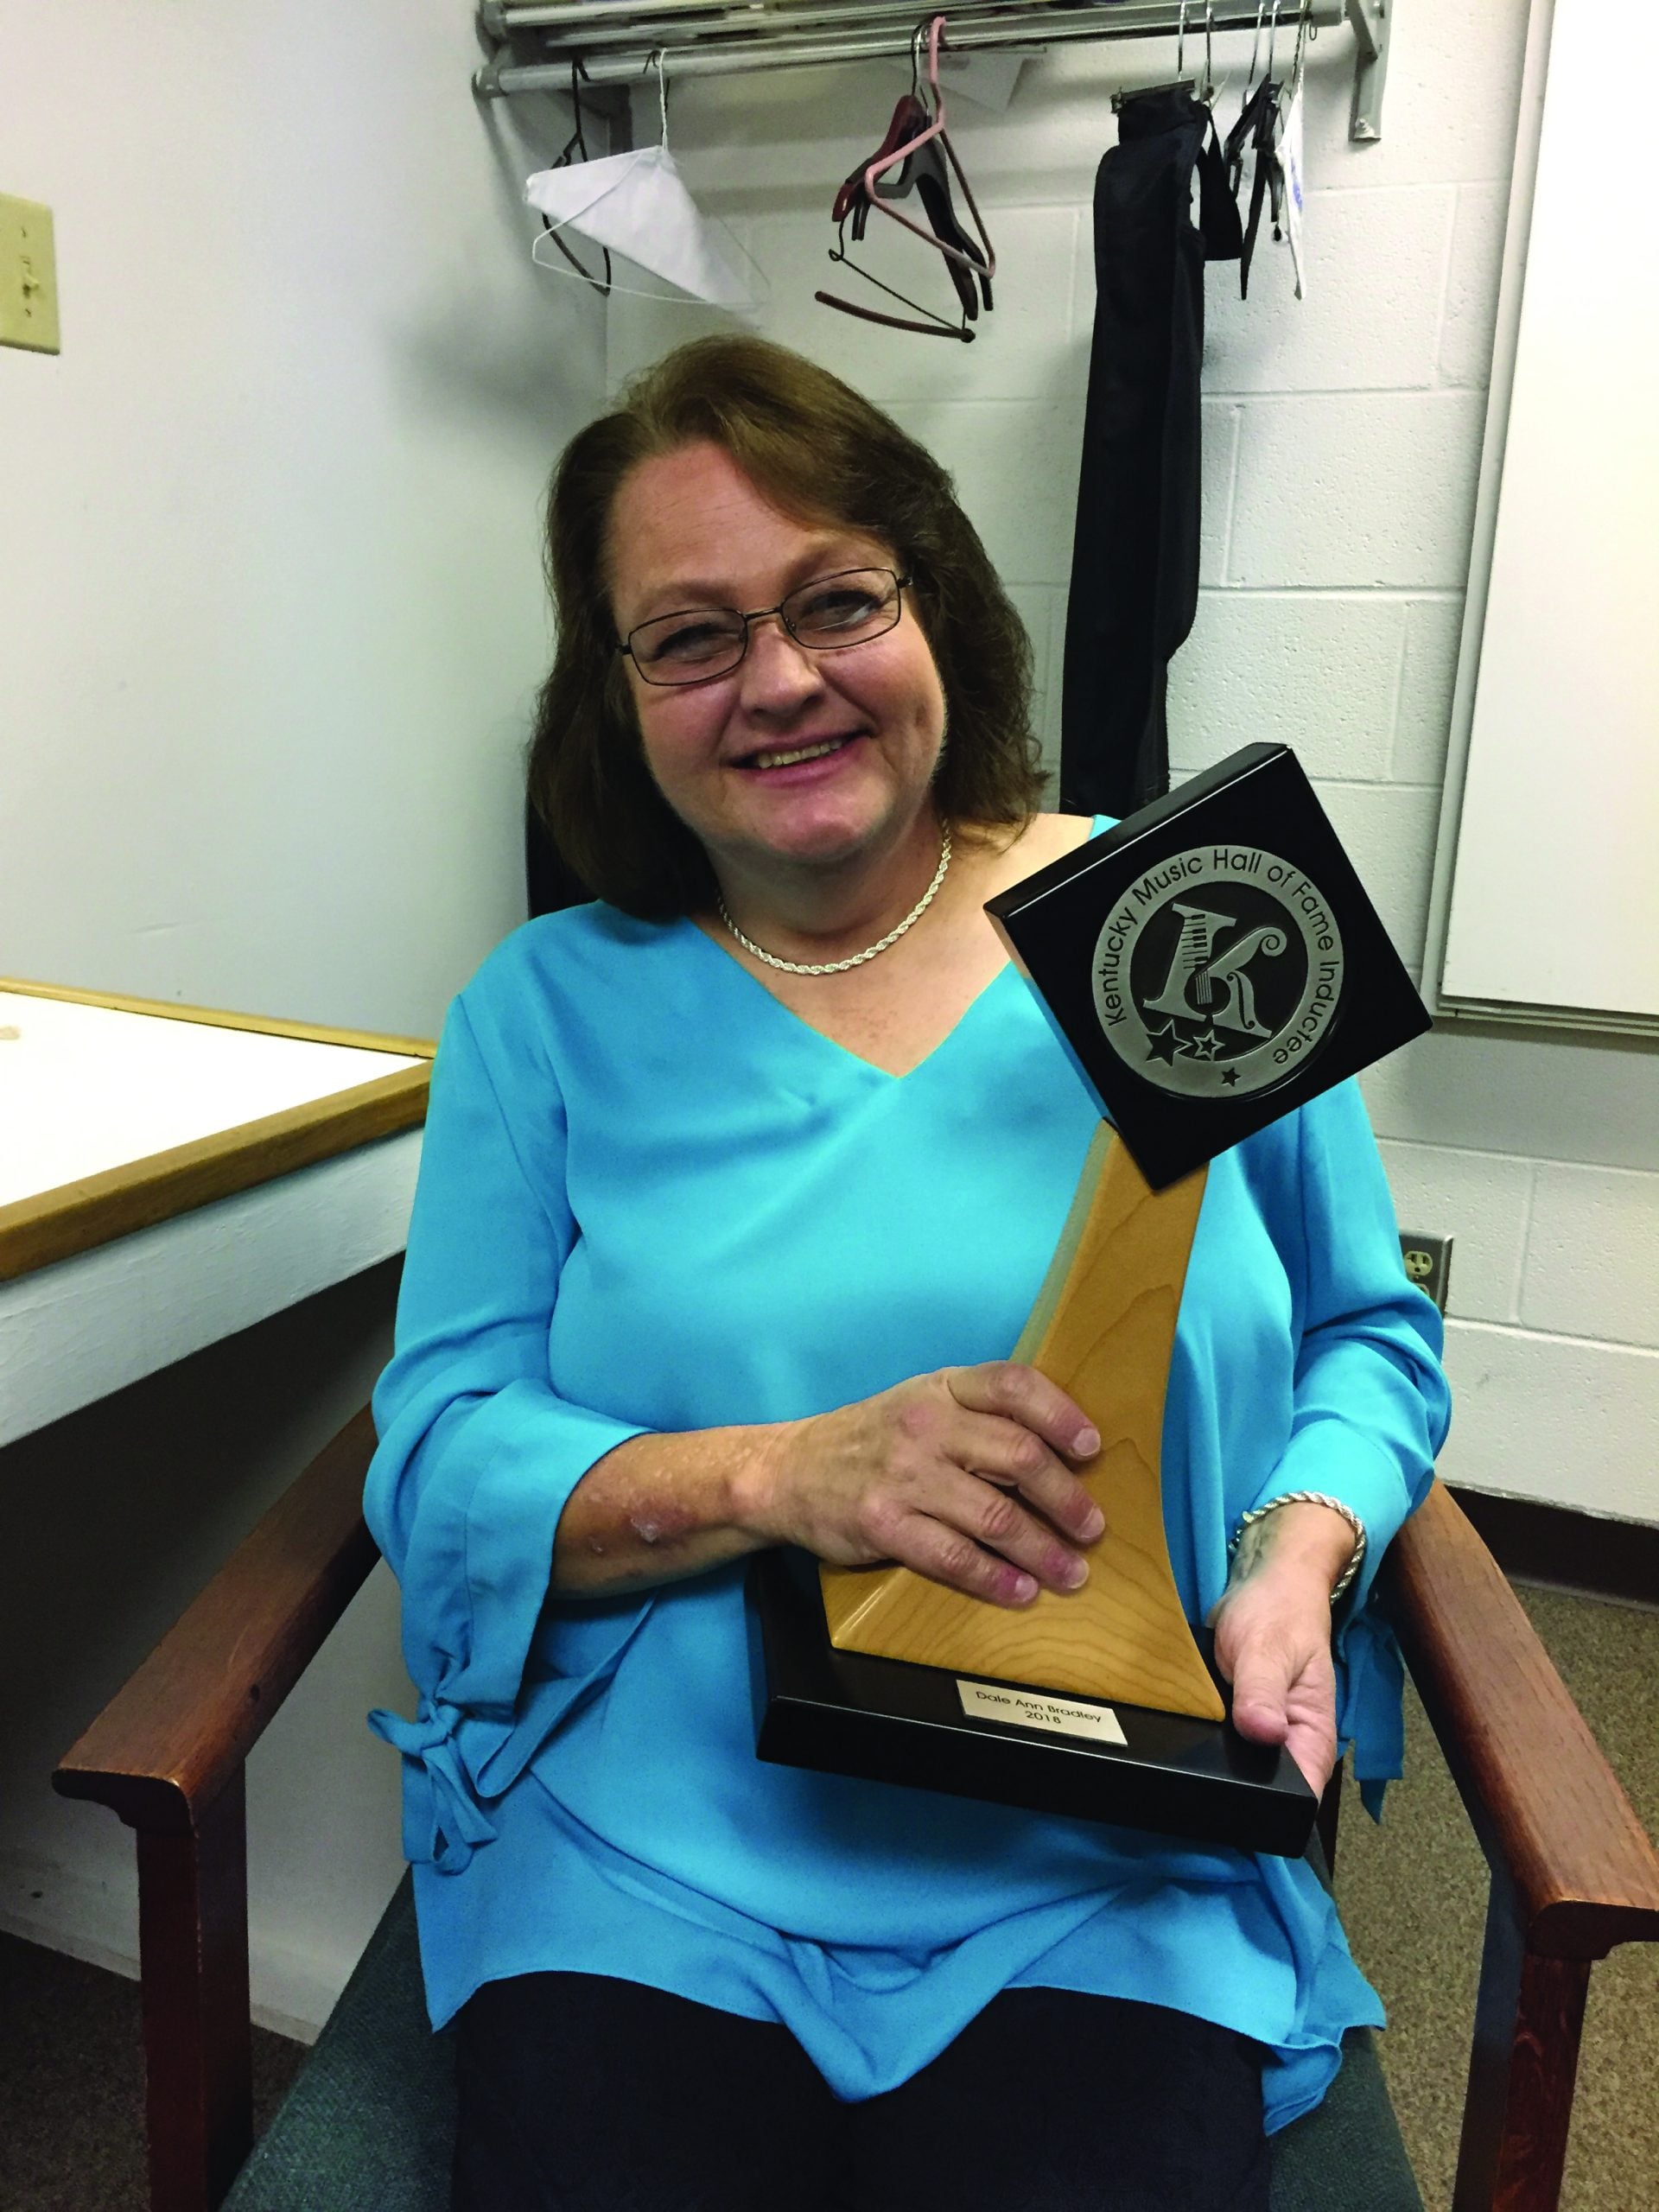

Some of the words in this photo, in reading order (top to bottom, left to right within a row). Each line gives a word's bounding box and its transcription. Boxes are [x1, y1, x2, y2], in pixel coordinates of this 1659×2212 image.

[1132, 856, 1204, 906] Music
[1213, 849, 1262, 874] Hall
[1267, 865, 1296, 888] of
[1292, 880, 1334, 951] Fame
[1098, 906, 1138, 1027] Kentucky
[1273, 960, 1340, 1064] Inductee
[976, 1691, 1011, 1705] Dale
[1015, 1699, 1044, 1712] Ann
[1047, 1705, 1102, 1723] Bradley
[1025, 1711, 1062, 1725] 2018
